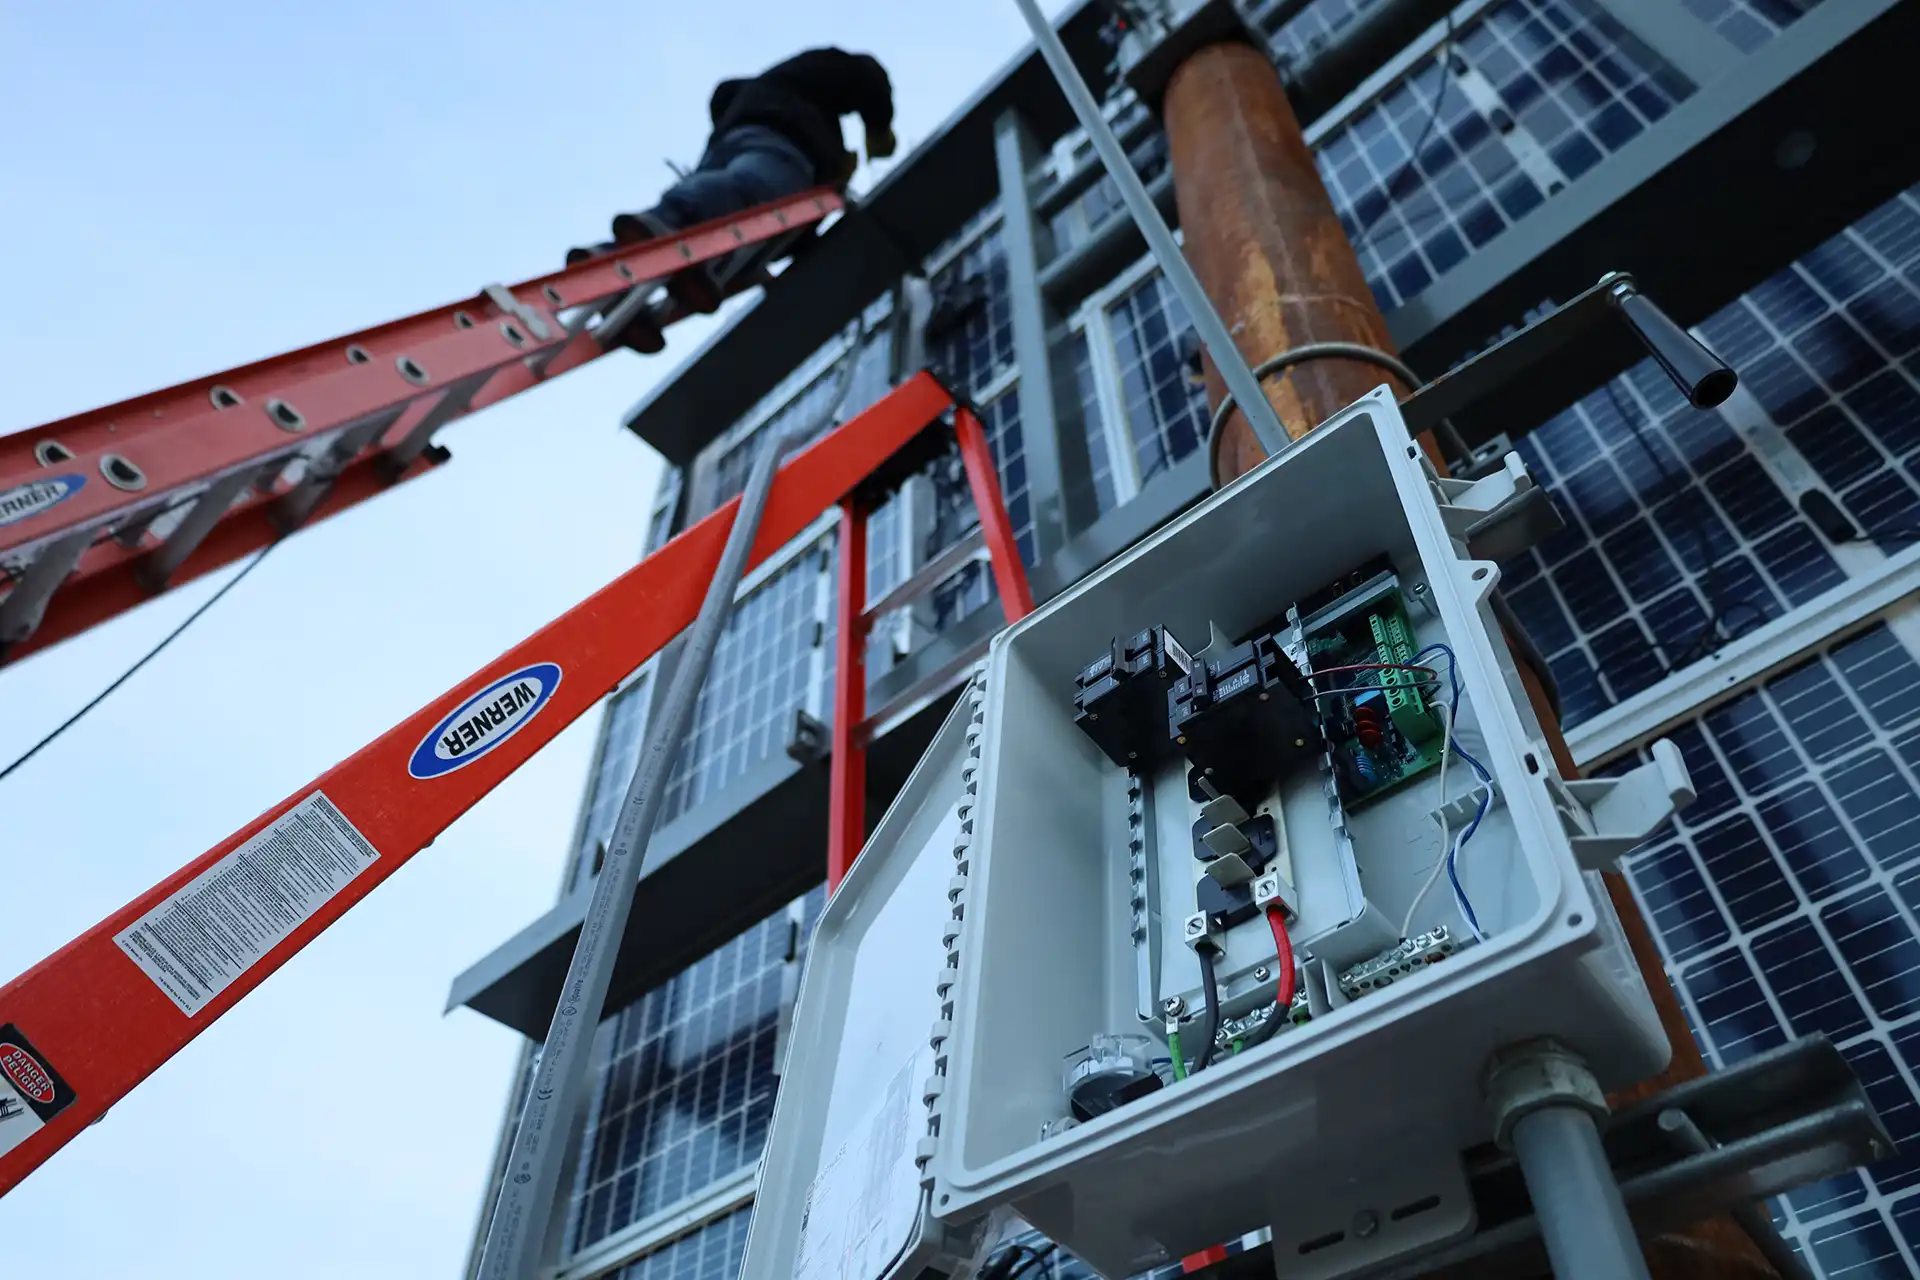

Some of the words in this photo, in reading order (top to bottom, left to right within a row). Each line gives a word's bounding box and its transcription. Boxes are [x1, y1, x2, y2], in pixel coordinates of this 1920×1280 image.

[442, 682, 537, 757] WERNER
[3, 1055, 42, 1097] PELIGRO
[13, 1051, 50, 1090] DANGER
